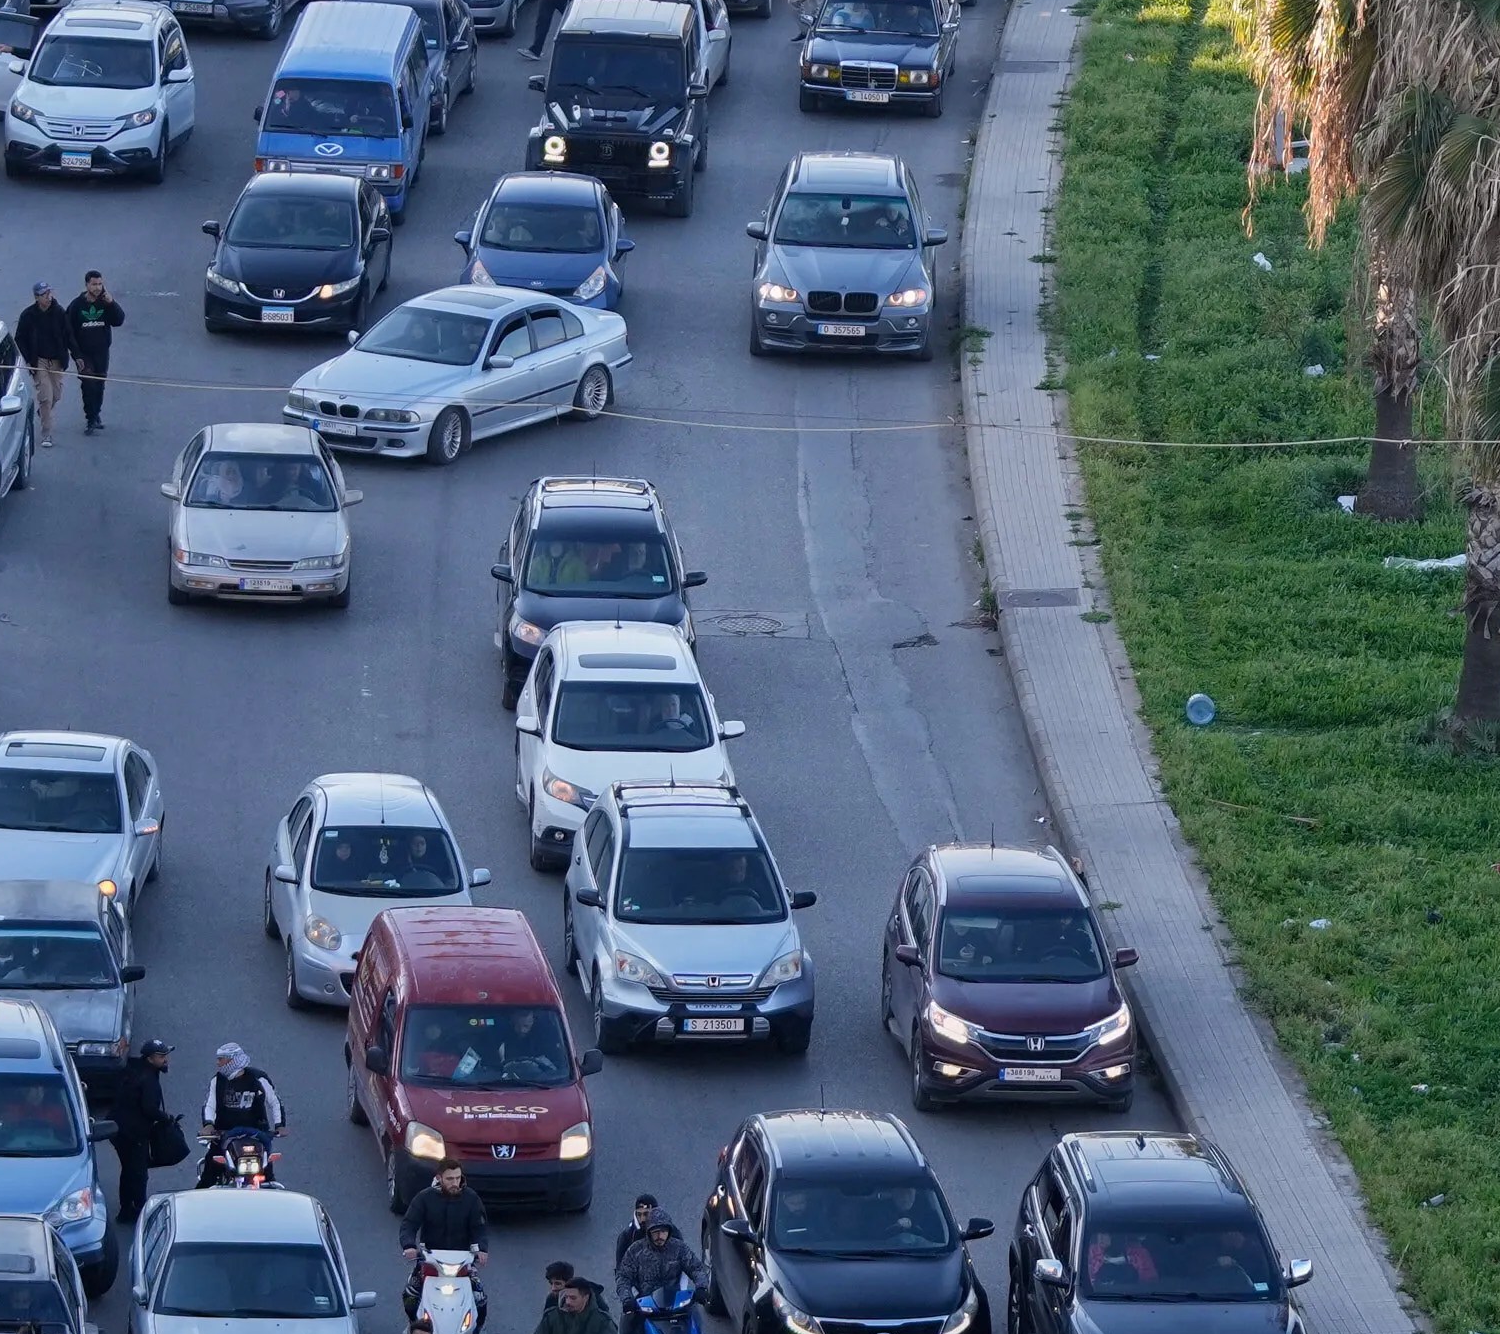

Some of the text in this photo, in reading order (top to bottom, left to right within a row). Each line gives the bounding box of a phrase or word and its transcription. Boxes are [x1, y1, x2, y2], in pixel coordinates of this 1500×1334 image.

[82, 320, 105, 328] adidas
[836, 325, 861, 335] 357565
[691, 1019, 738, 1031] S 213501
